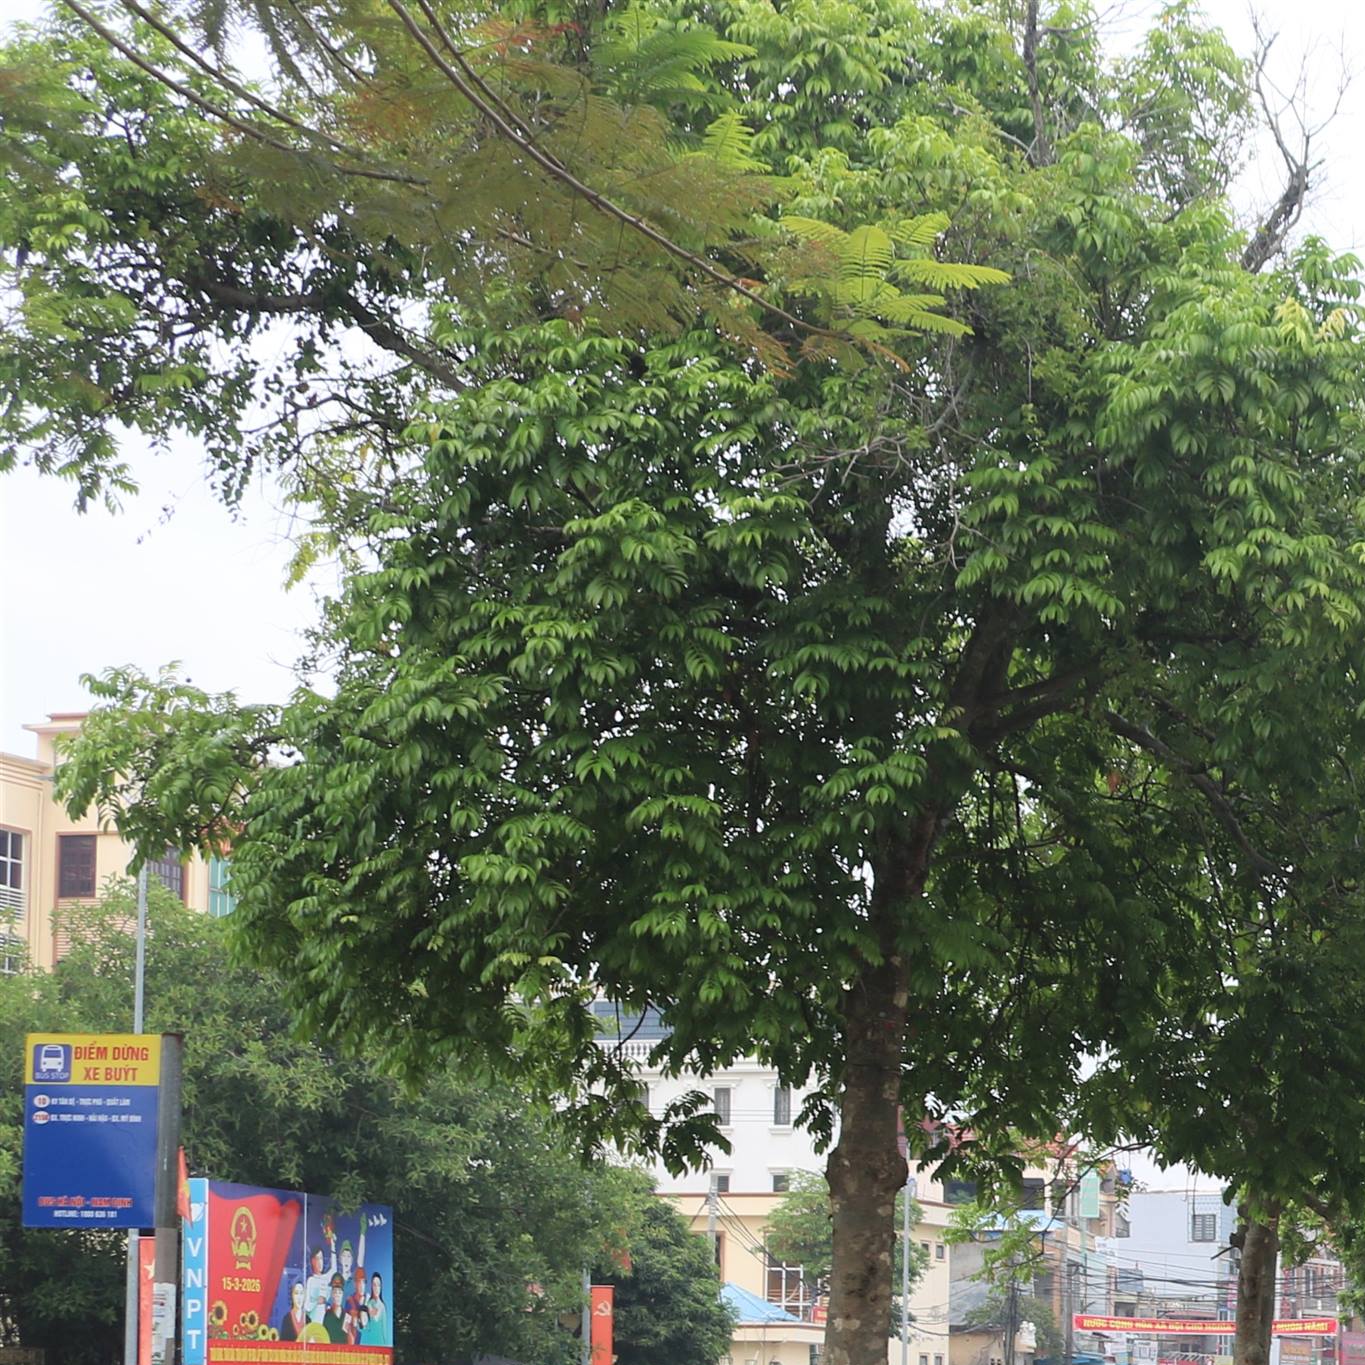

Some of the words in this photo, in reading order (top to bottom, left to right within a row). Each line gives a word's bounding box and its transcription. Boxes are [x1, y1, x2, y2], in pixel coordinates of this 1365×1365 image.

[74, 1040, 108, 1060] ĐIỂM
[112, 1043, 150, 1061] DỪNG
[34, 1071, 51, 1080] BUS
[51, 1071, 70, 1080] STOP
[84, 1067, 100, 1081] XE
[105, 1064, 139, 1081] BUÝT
[187, 1237, 203, 1349] VNPT
[222, 1277, 261, 1293] 15-3-2026
